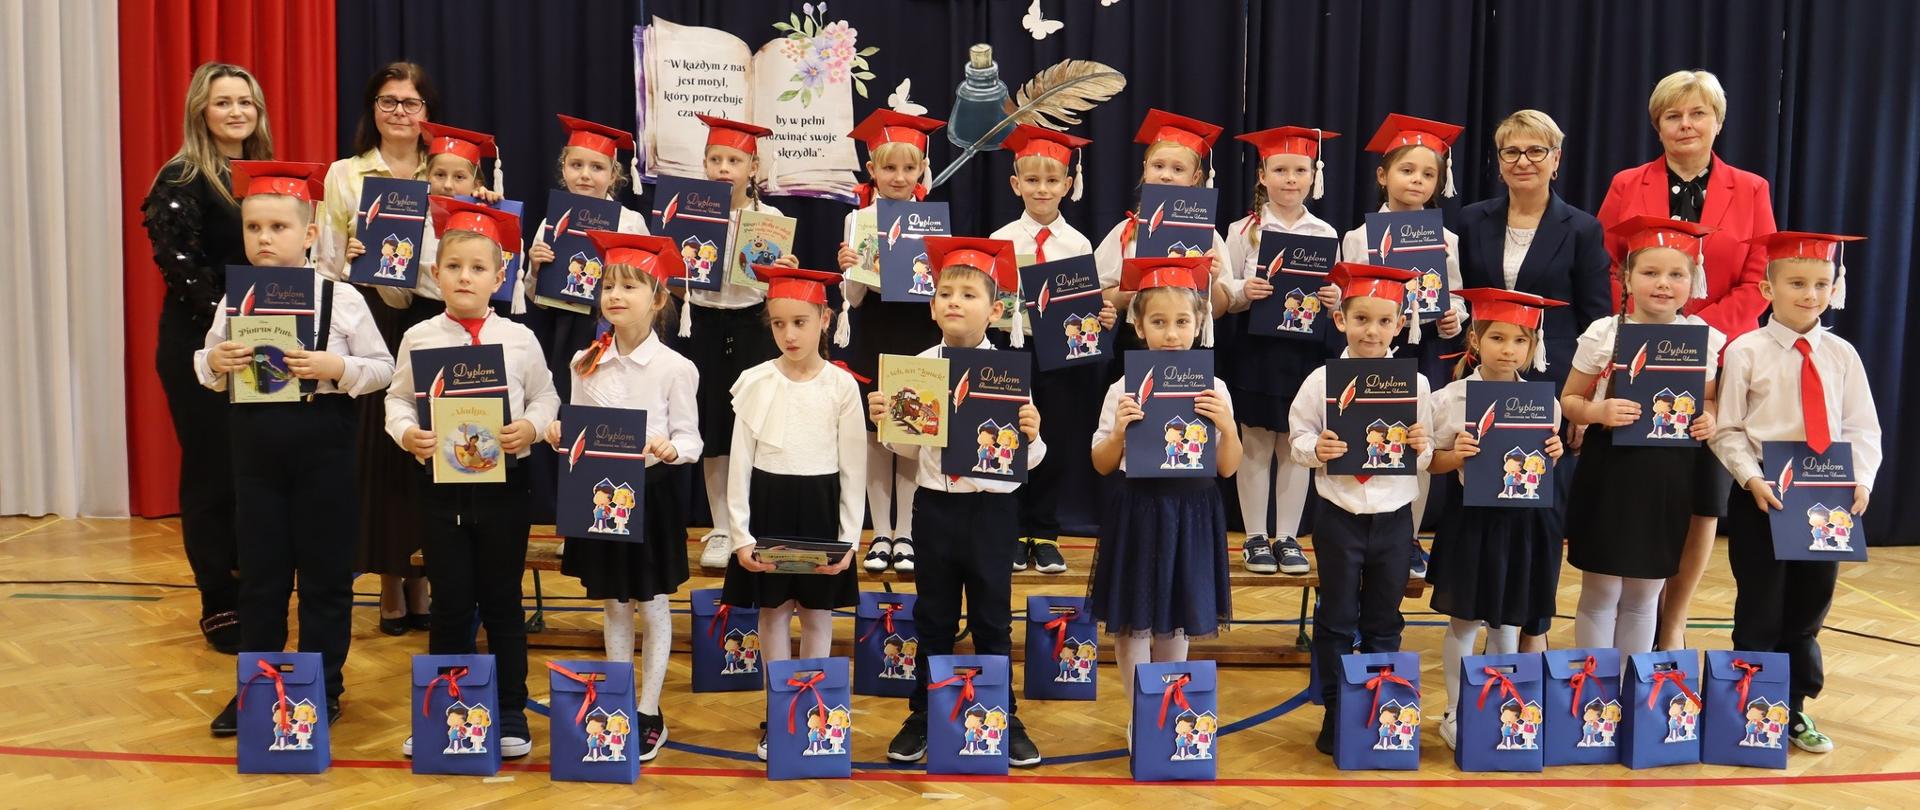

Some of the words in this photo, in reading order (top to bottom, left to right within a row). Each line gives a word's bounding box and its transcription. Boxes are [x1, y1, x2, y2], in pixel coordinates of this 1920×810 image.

[683, 59, 720, 72] każdym
[730, 64, 746, 72] nas
[676, 76, 695, 87] jest
[697, 77, 728, 89] motyl,
[664, 90, 690, 103] który
[692, 93, 744, 106] potrzebuje
[776, 115, 787, 127] by
[790, 117, 799, 125] w
[810, 132, 837, 144] swoje
[687, 192, 721, 208] Dyplom
[1173, 199, 1207, 214] Dyplom
[908, 213, 942, 228] Dyplom
[1400, 224, 1435, 239] Dyplom
[1292, 247, 1327, 263] Dyplom
[1055, 273, 1090, 287] Dyplom
[265, 282, 304, 299] Dyplom
[1657, 339, 1698, 356] Dyplom
[453, 363, 495, 379] Dyplom
[980, 367, 1020, 384] Dyplom
[1163, 366, 1204, 382] Dyplom
[1365, 374, 1407, 389] Dyplom
[1505, 397, 1544, 414] Dyplom
[595, 424, 635, 442] Dyplom
[1802, 456, 1844, 472] Dyplom
